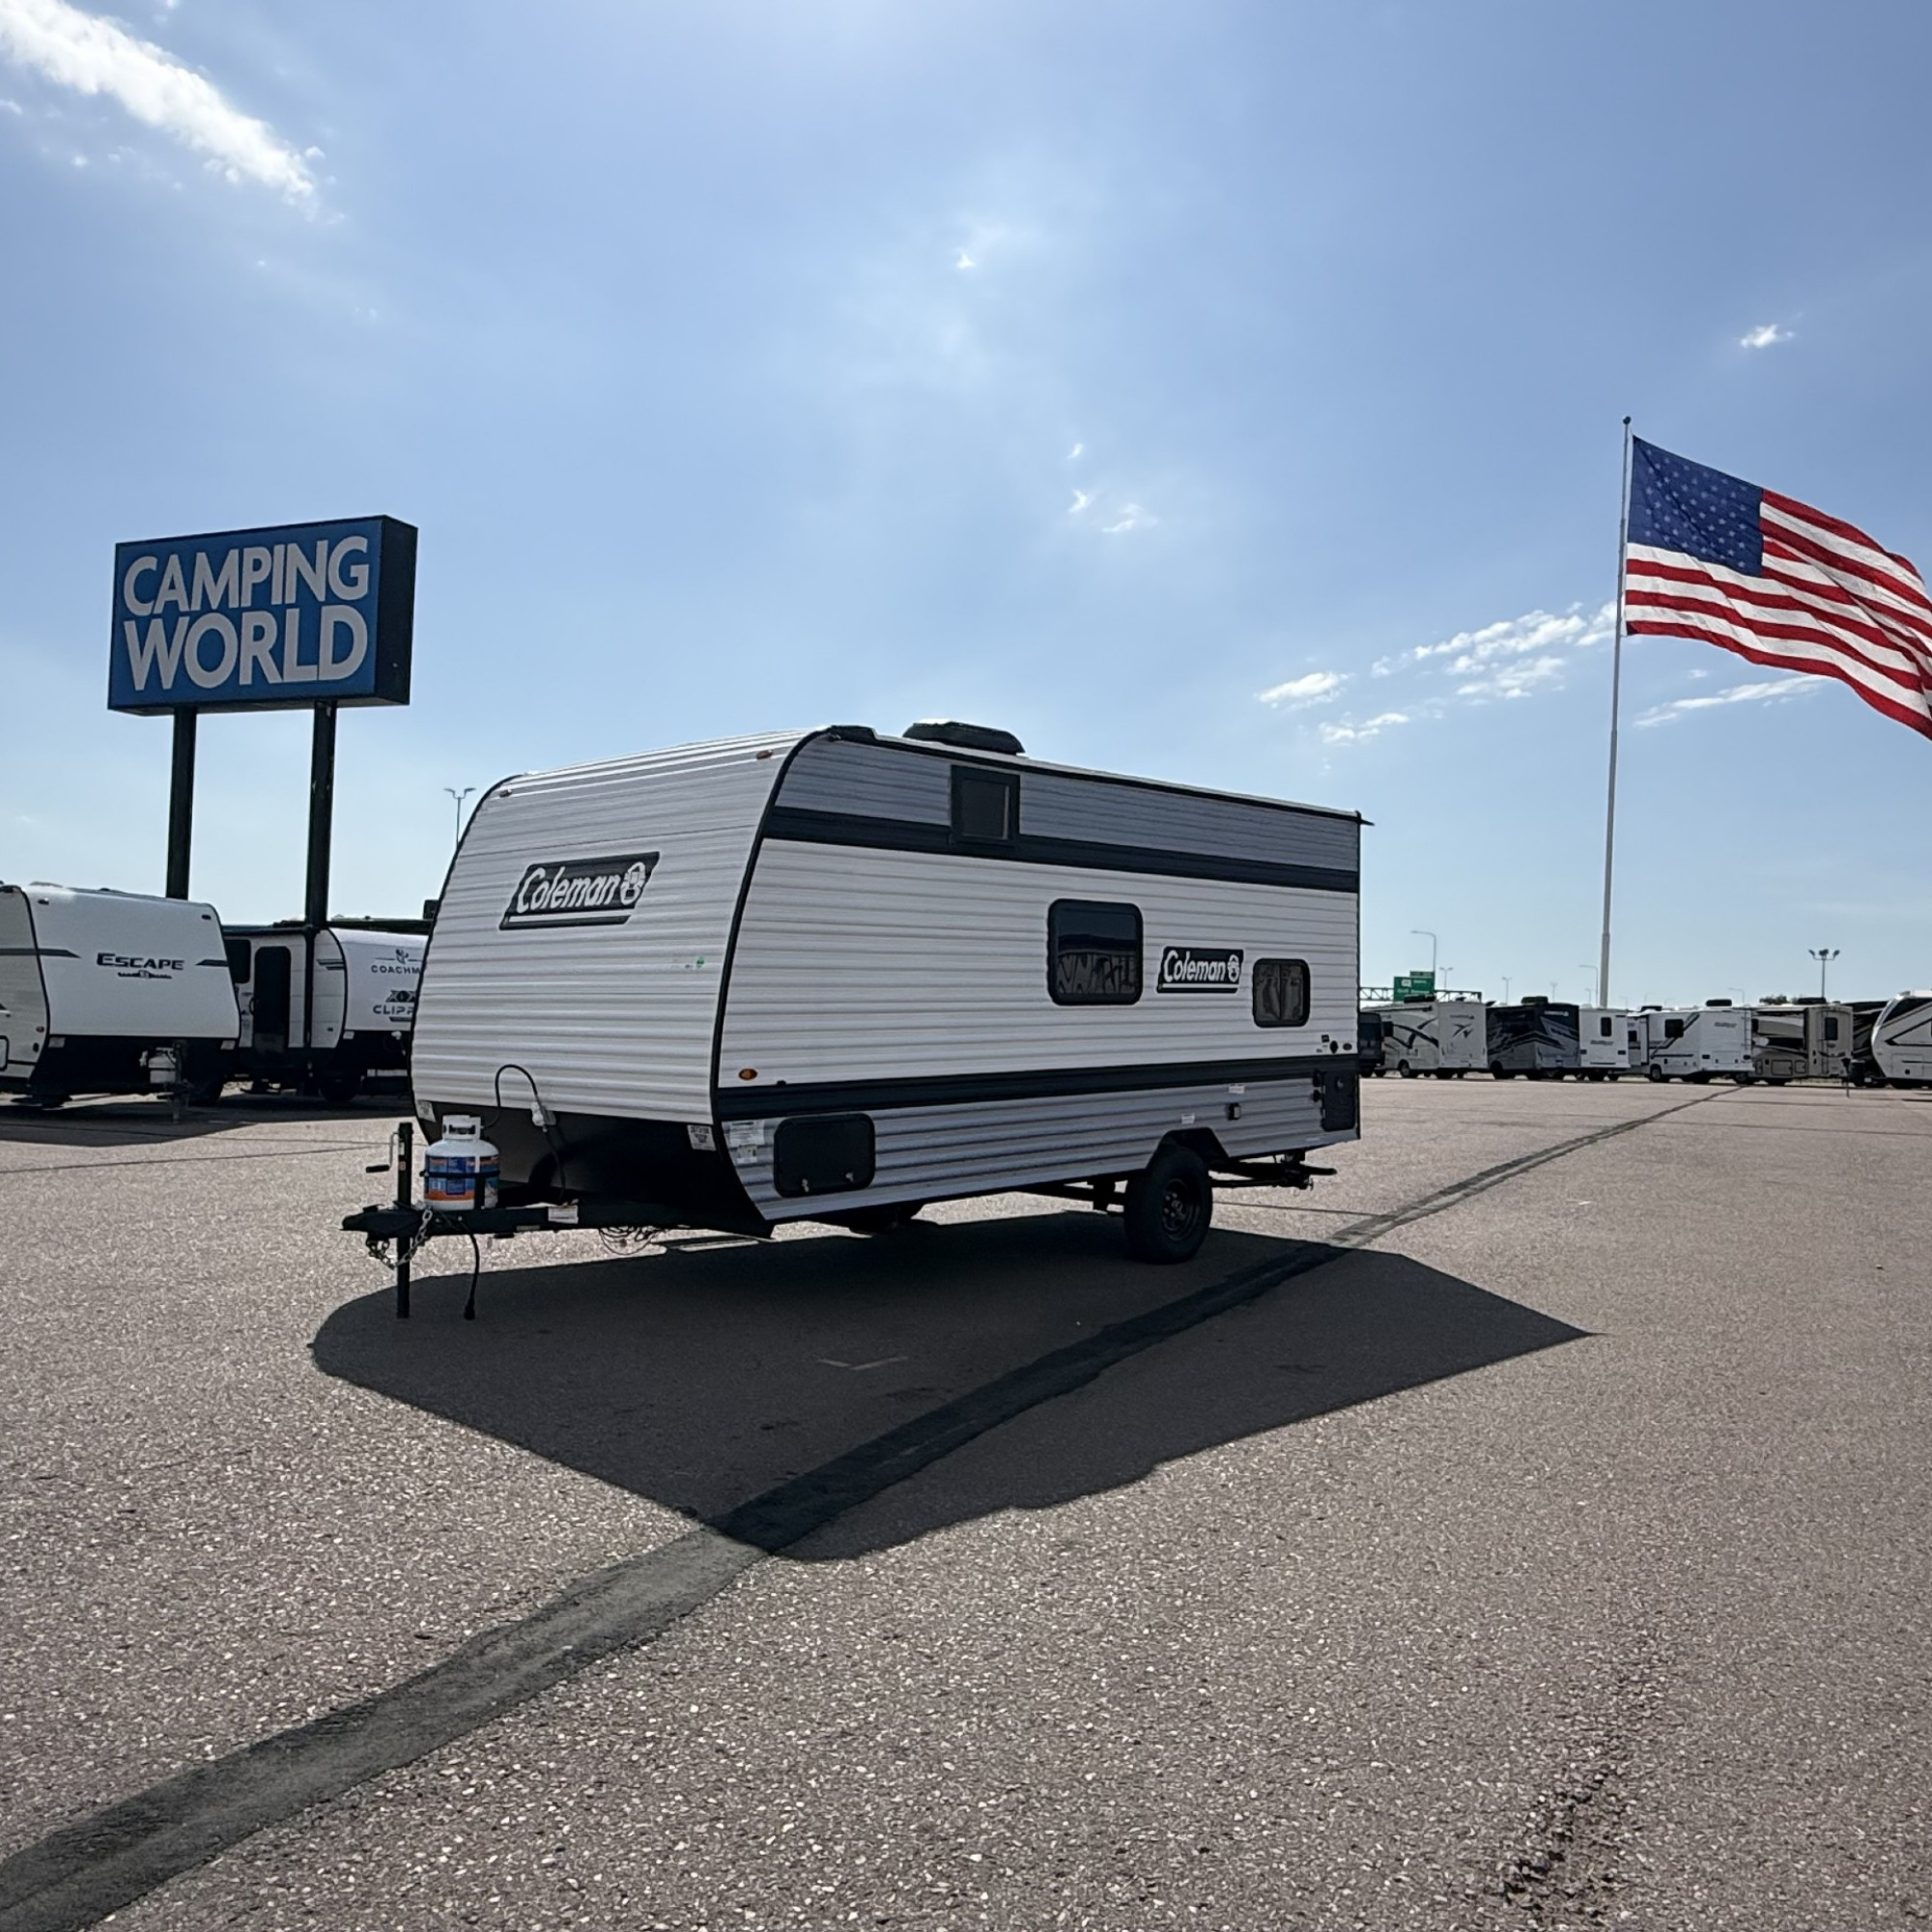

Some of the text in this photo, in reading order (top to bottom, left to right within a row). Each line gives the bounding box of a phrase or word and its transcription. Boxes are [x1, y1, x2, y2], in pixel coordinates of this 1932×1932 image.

[124, 535, 369, 616] CAMPING
[124, 605, 368, 691] WORLD
[517, 867, 621, 913] Coleman
[97, 952, 185, 971] ESCAPE
[1163, 950, 1226, 982] Coleman
